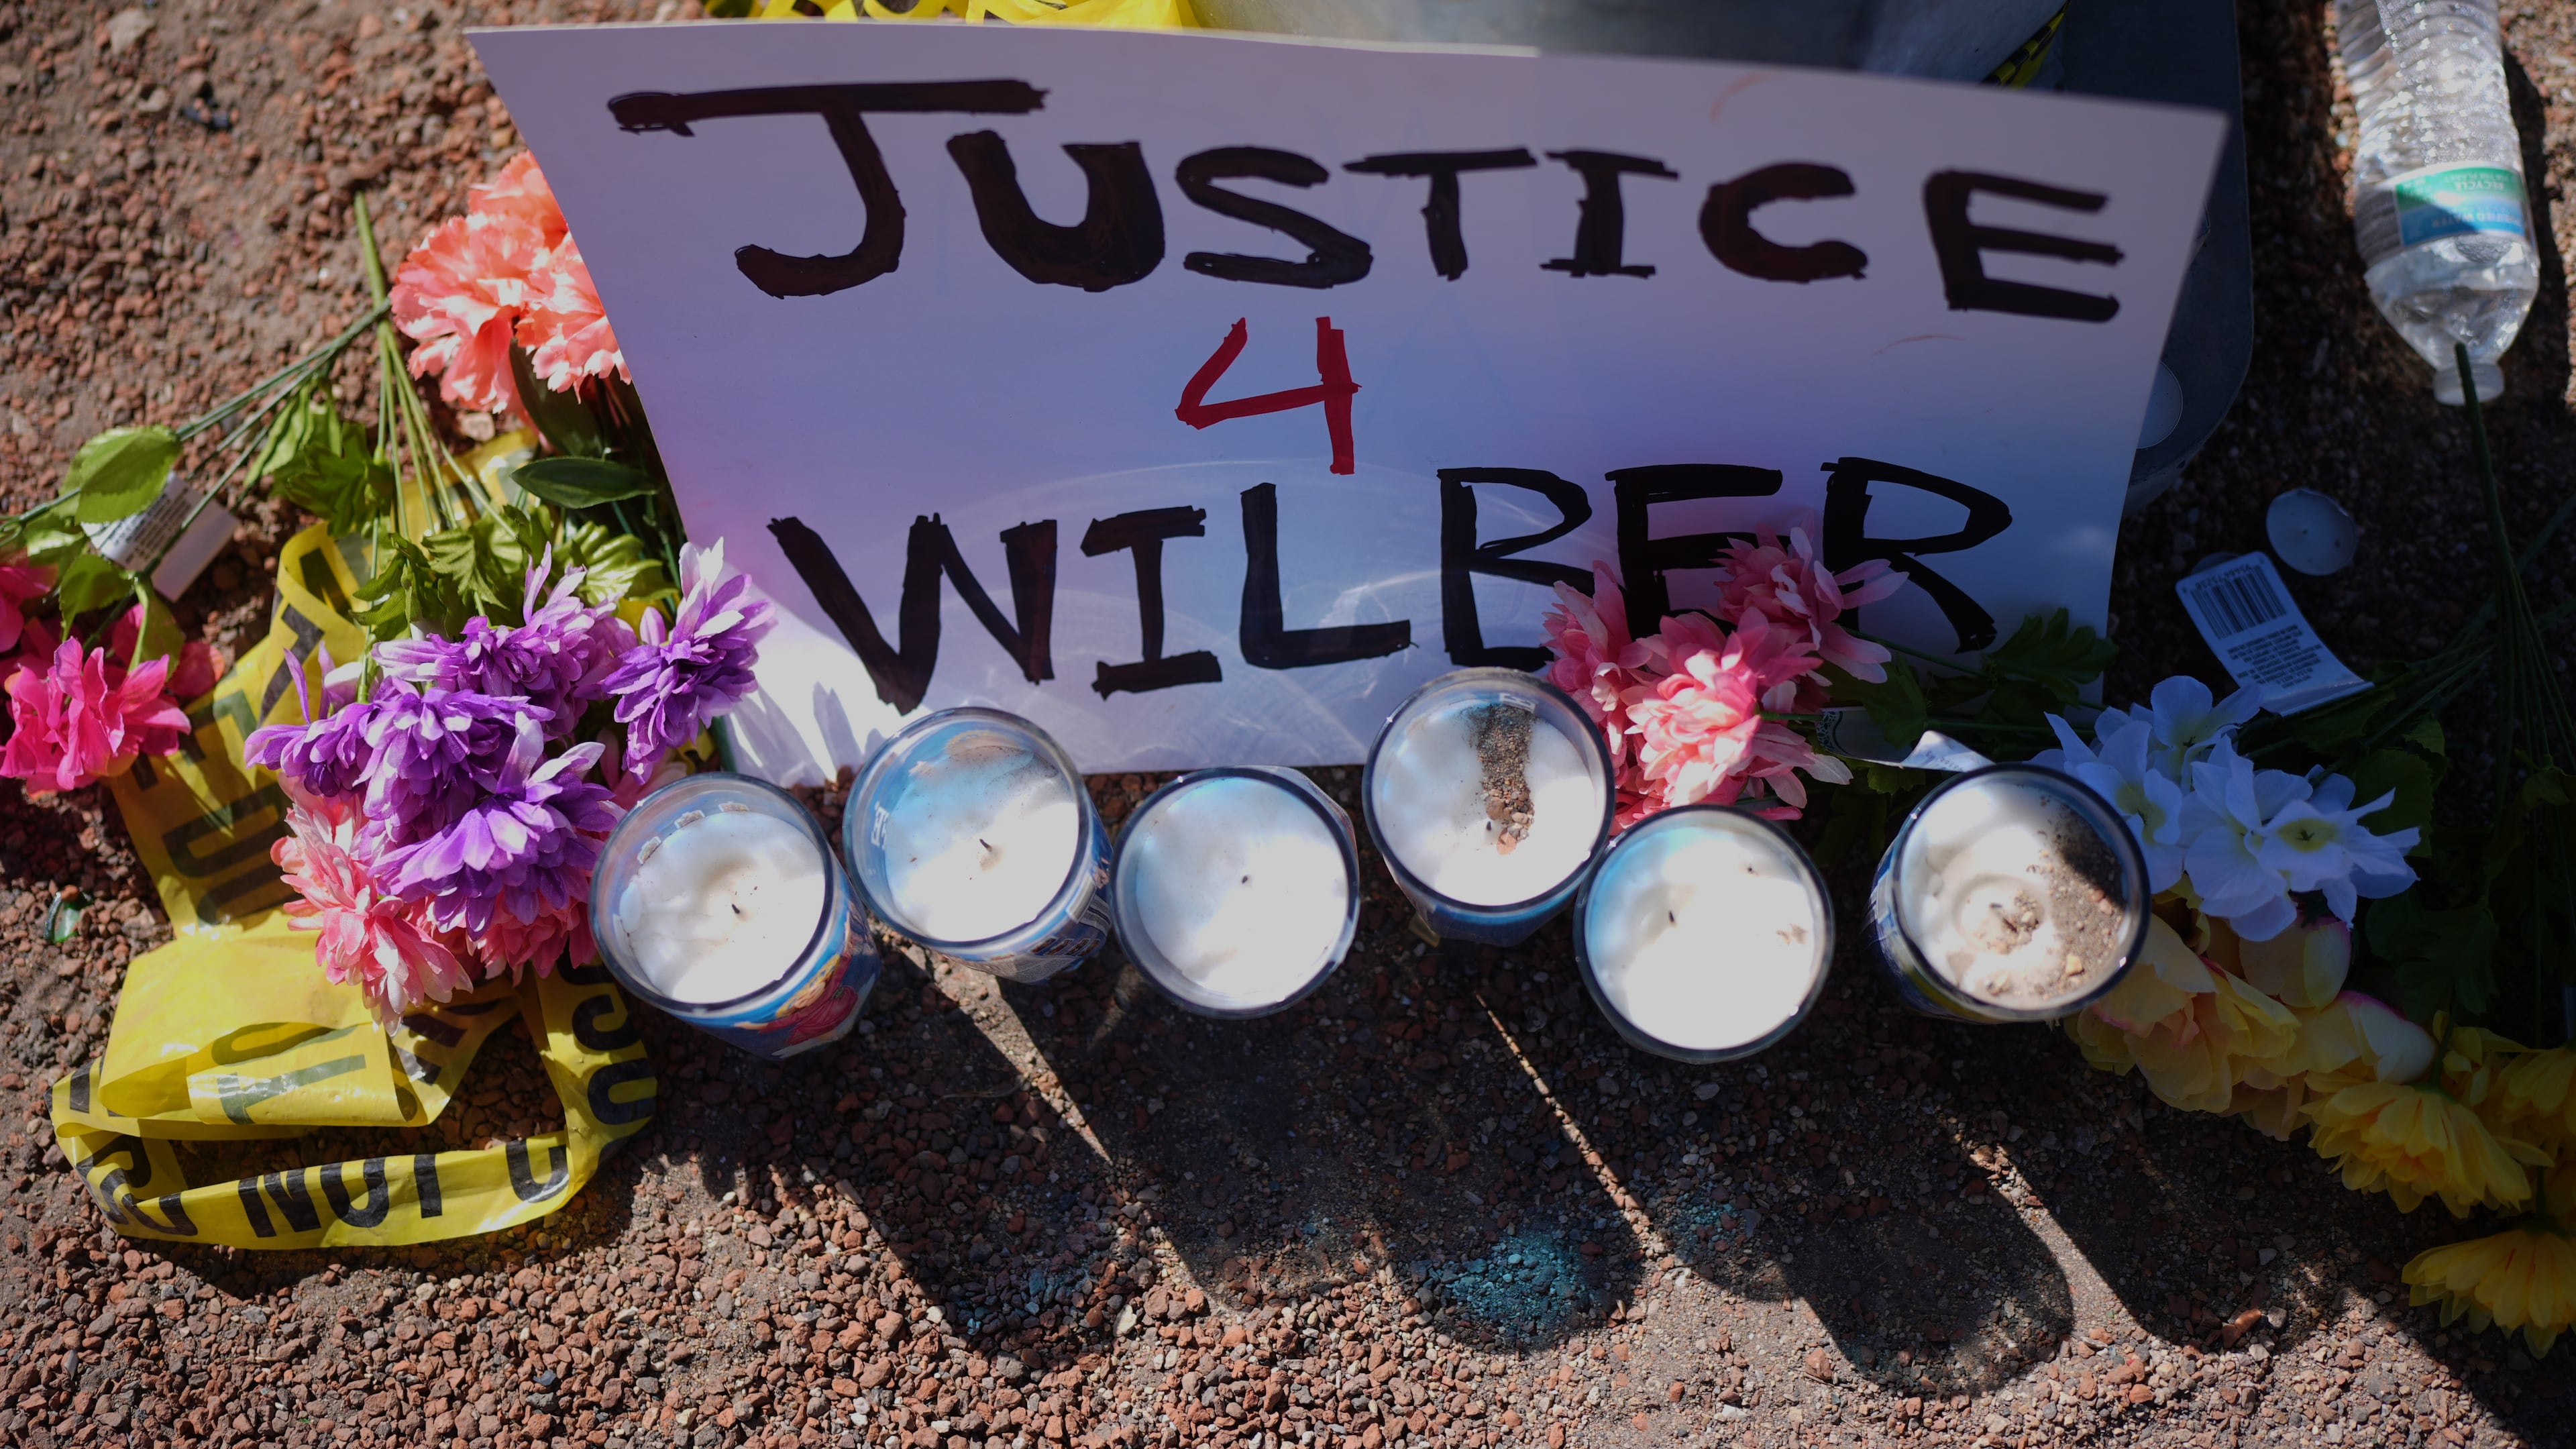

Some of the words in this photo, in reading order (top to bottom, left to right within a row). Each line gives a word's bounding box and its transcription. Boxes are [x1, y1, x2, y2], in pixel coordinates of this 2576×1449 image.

[607, 79, 2125, 323] JUSTICE
[1177, 317, 1362, 475] 4
[767, 457, 2013, 714] WILBER
